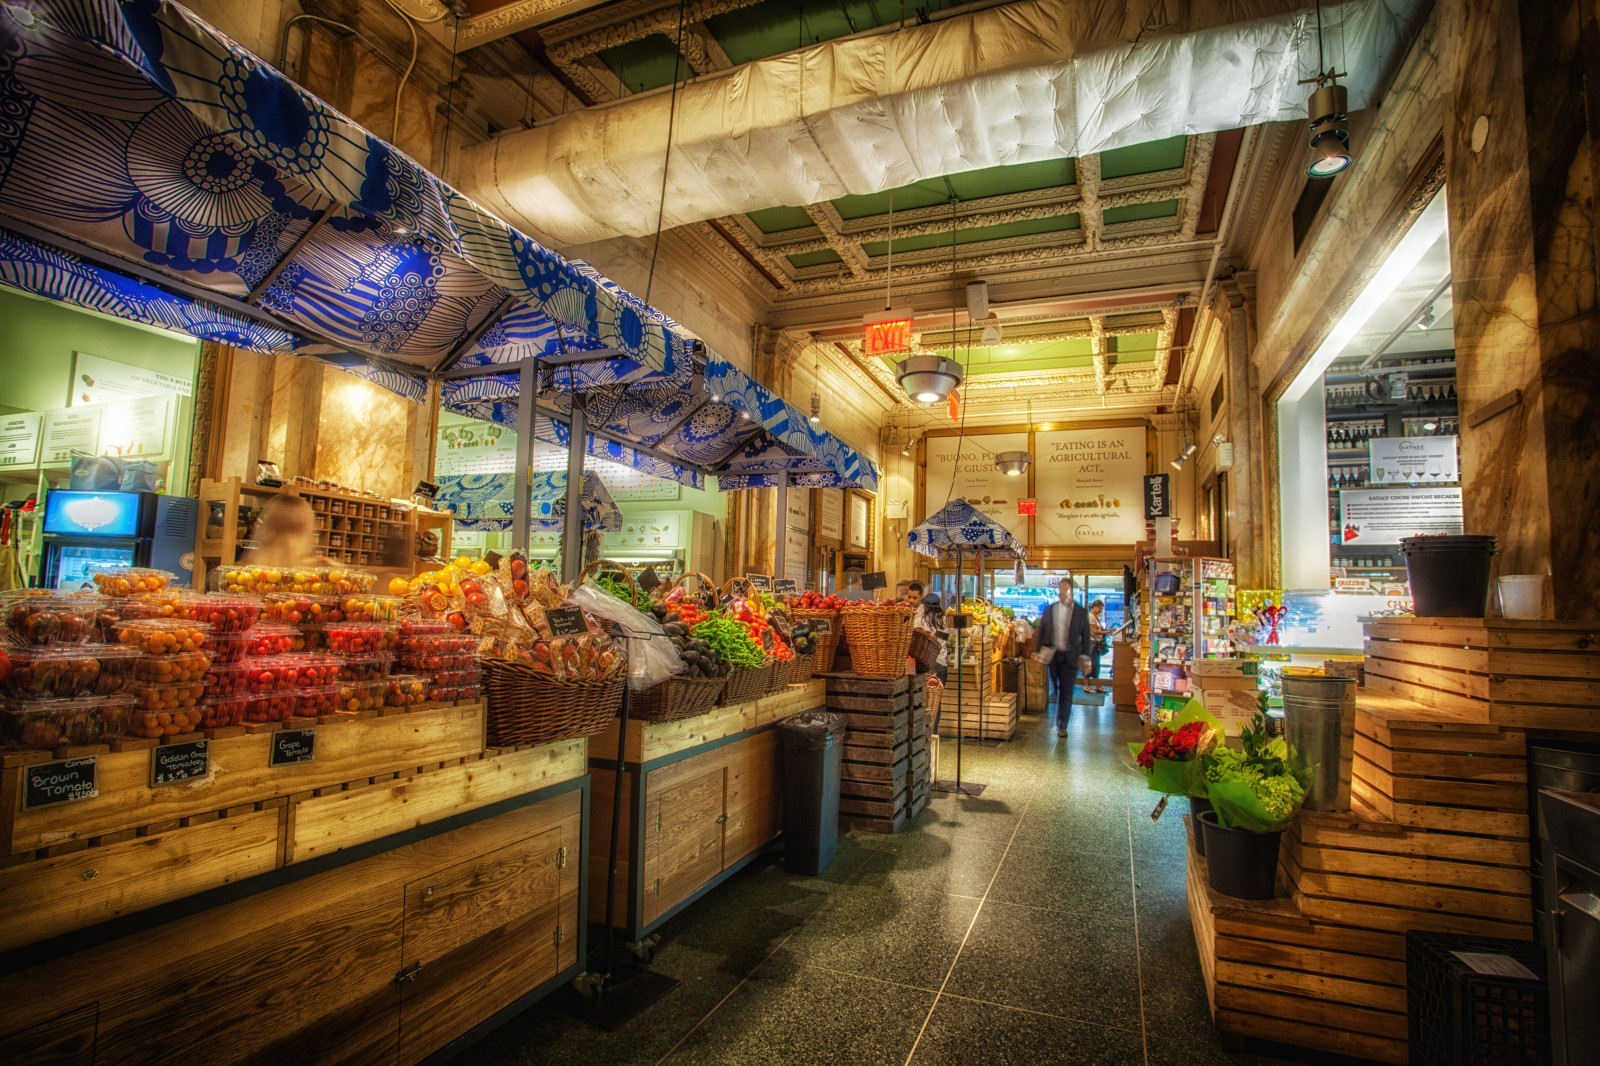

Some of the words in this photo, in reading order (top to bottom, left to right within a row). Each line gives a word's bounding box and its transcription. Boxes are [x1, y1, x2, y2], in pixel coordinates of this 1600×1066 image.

[872, 321, 905, 352] EXIT
[1097, 440, 1107, 449] IS
[1109, 440, 1124, 448] AN
[1048, 451, 1132, 462] AGRICULTURAL
[956, 465, 962, 473] E
[1149, 476, 1163, 516] Kartell
[160, 754, 189, 765] Golden
[32, 772, 79, 788] Brown
[41, 781, 93, 797] Tomato
